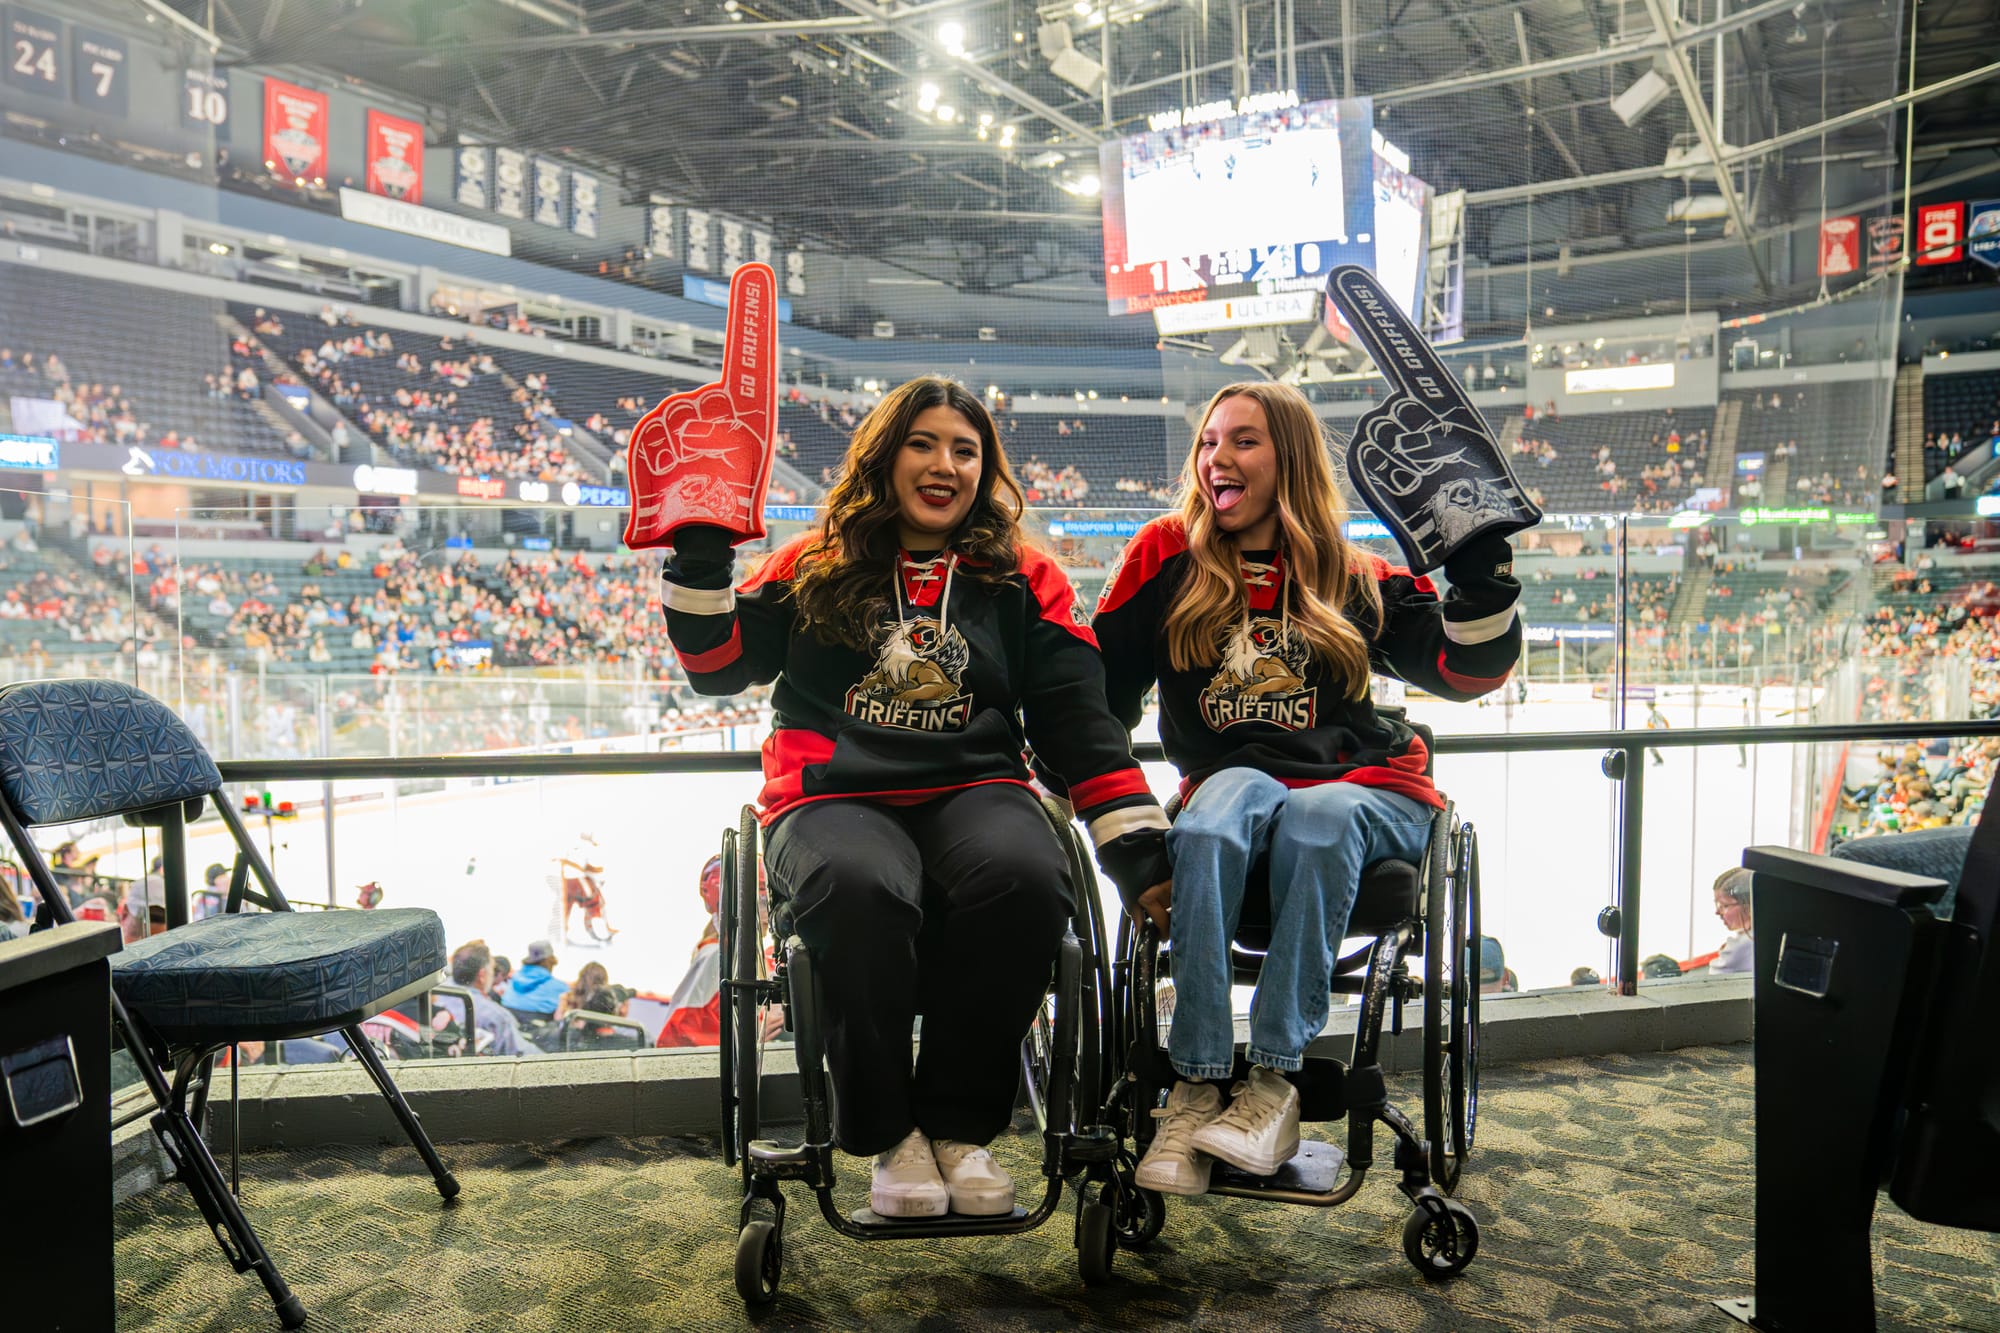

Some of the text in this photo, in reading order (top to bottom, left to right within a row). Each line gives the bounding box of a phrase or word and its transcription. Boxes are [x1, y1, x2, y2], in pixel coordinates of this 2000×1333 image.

[14, 40, 56, 81] 24
[92, 62, 114, 96] 7
[188, 87, 226, 124] 10
[1148, 89, 1299, 132] VAN ANDEL ARENA
[1301, 243, 1320, 273] 0
[1150, 263, 1164, 290] 1
[1238, 298, 1303, 318] ULTRA
[740, 281, 760, 398] GO GRIFFINS!
[1350, 284, 1444, 398] GO GRIFFINS!
[151, 450, 306, 485] FOX MOTORS
[580, 485, 627, 506] PEPSI
[851, 692, 964, 732] GRIFFINS
[1206, 696, 1310, 730] GRIFFINS
